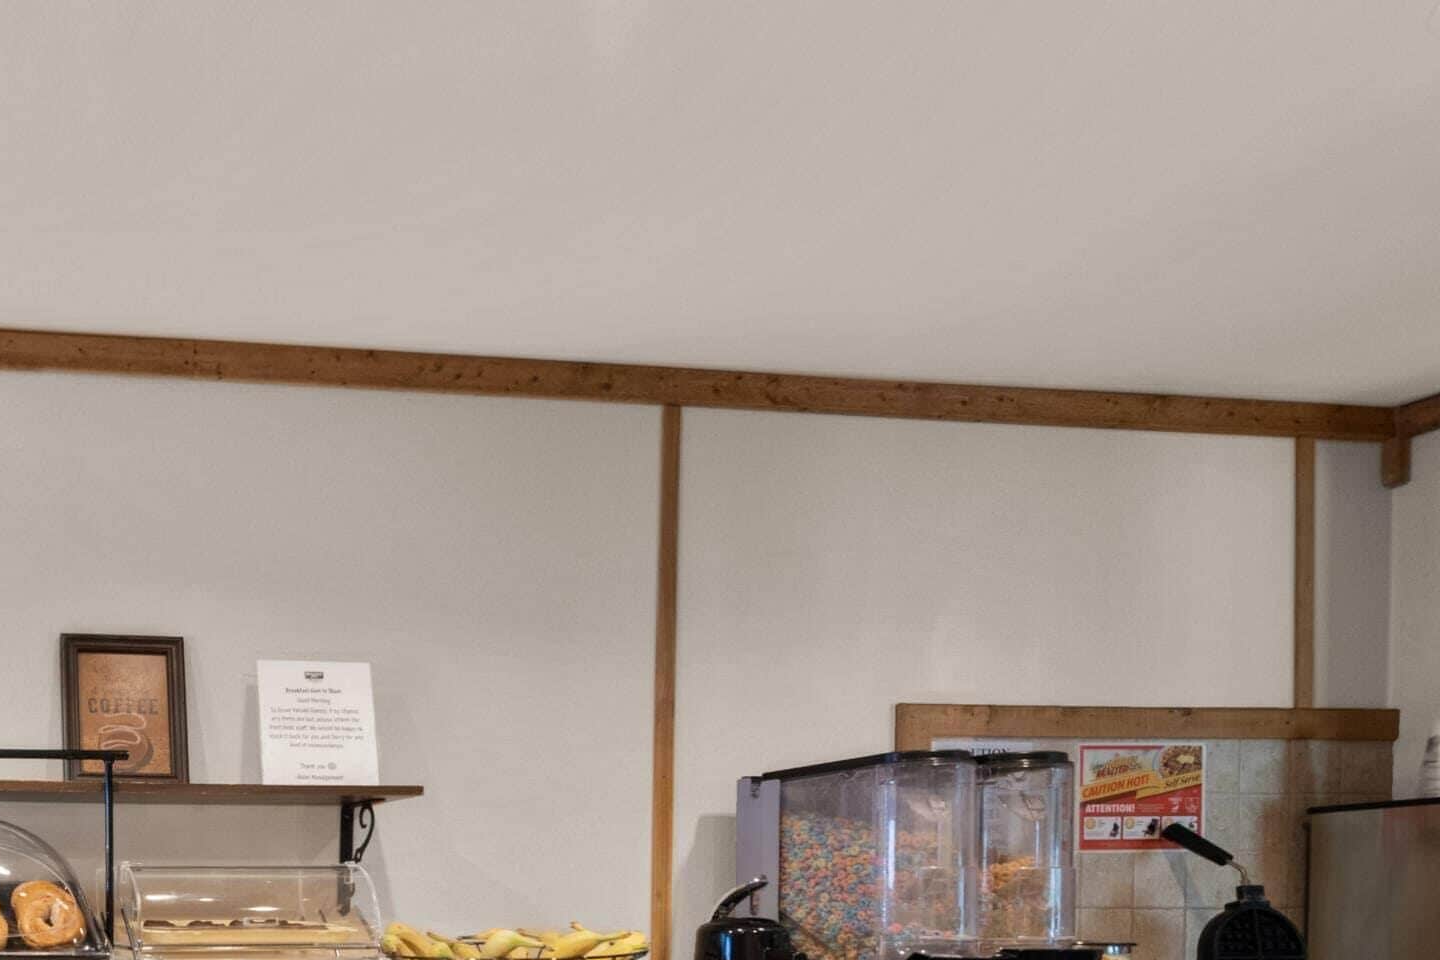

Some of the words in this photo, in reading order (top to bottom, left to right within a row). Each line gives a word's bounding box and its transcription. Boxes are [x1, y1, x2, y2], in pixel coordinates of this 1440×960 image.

[87, 697, 159, 715] COFFEE
[1082, 779, 1127, 798] CAUTION
[1085, 803, 1136, 814] ATTENTION!
